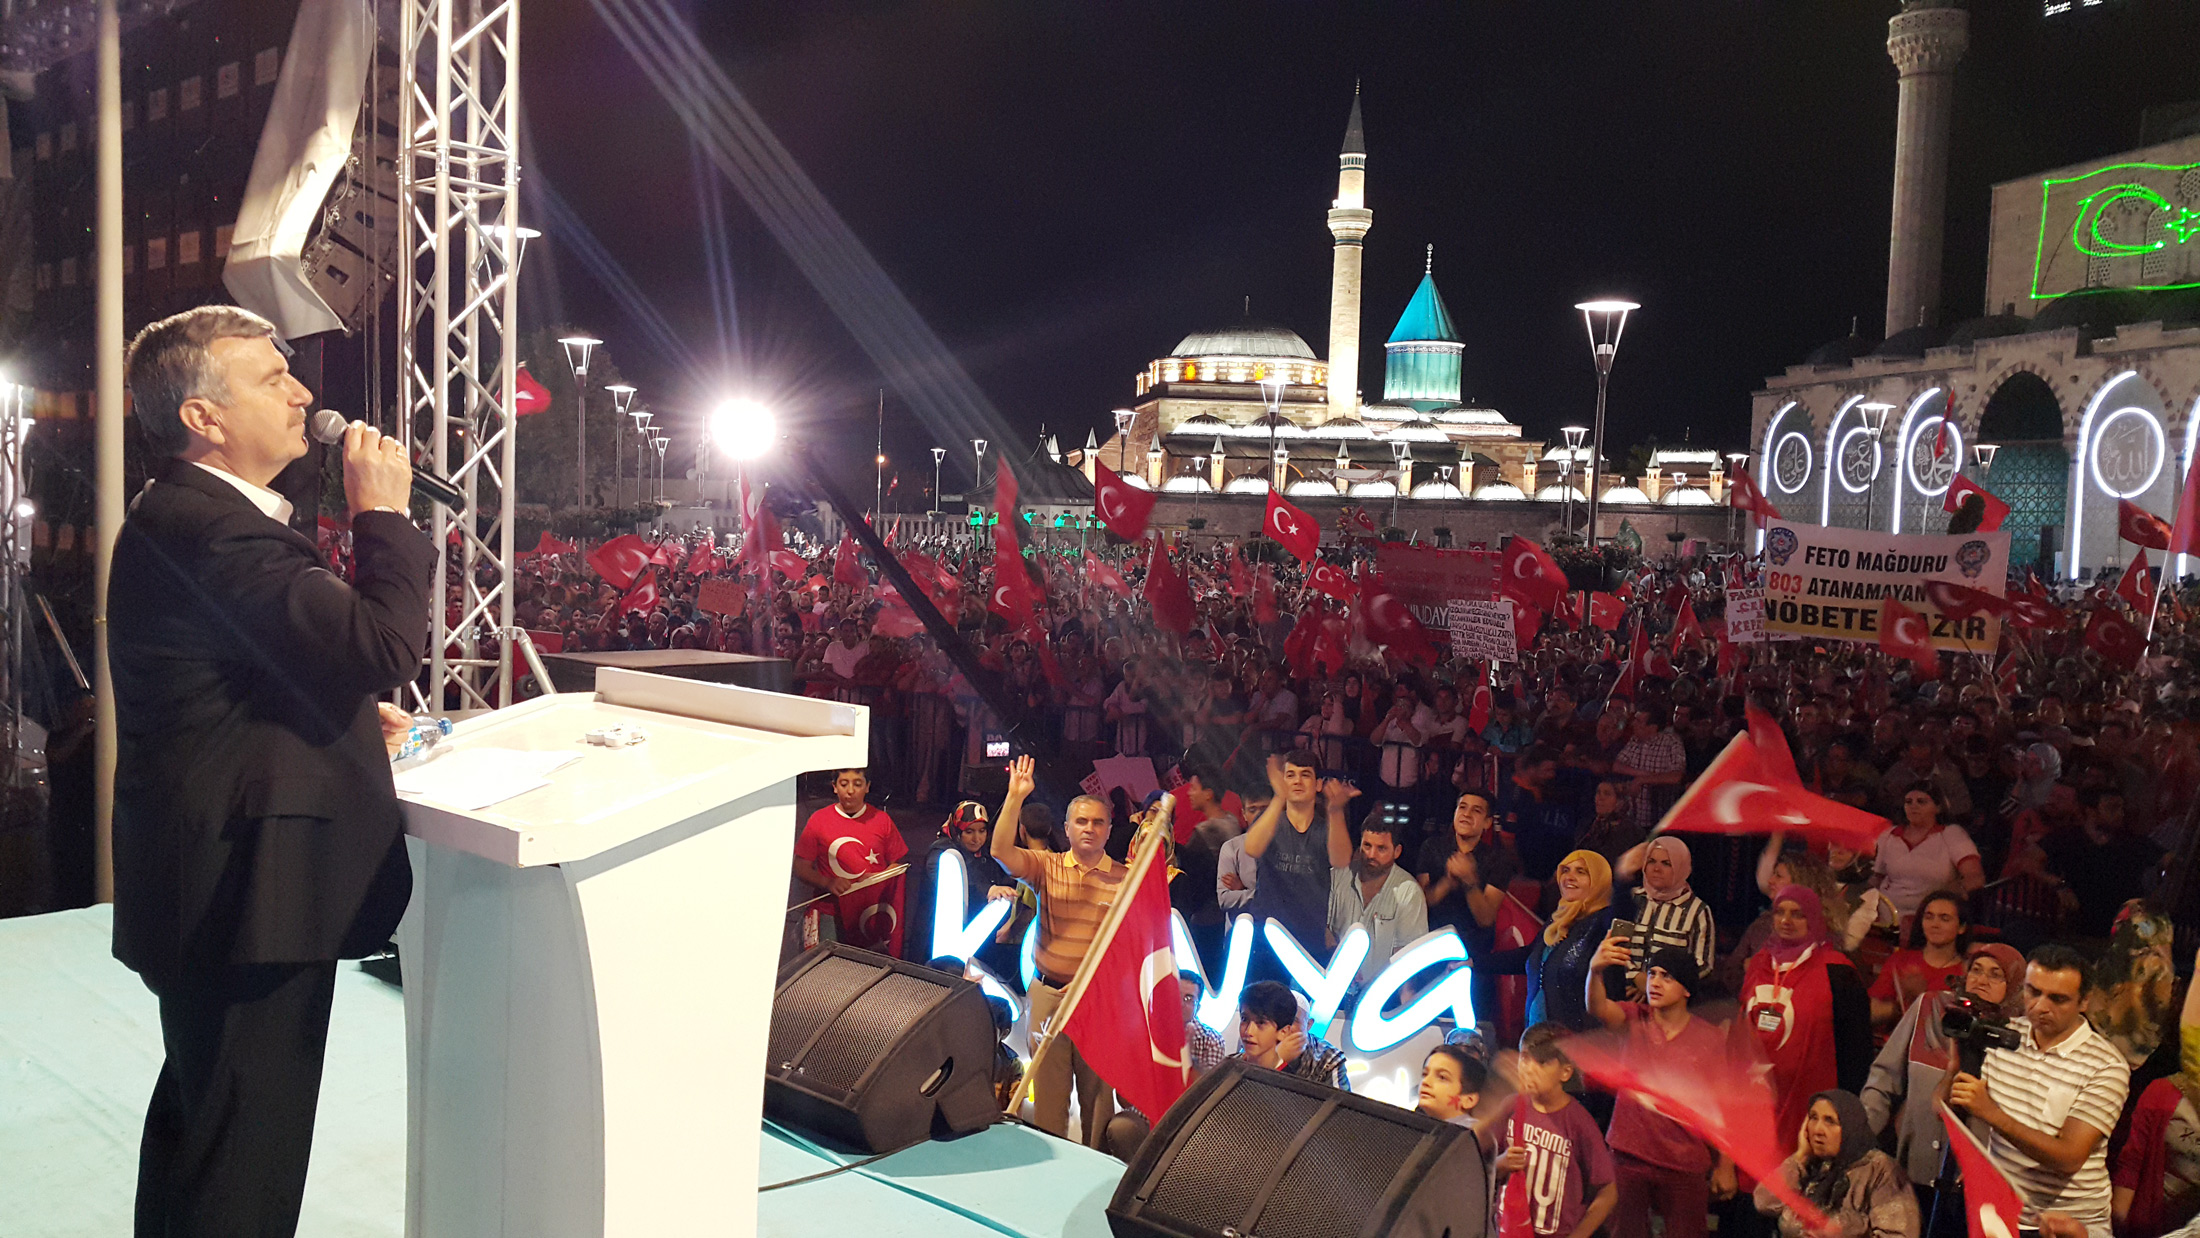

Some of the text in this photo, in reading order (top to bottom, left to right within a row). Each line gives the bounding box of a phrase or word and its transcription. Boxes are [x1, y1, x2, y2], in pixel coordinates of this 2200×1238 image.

[1804, 545, 1948, 573] FETO MAĞDURU
[1769, 571, 1926, 602] 803 ATANAMAYAN
[1764, 594, 1878, 632] NÖBETE
